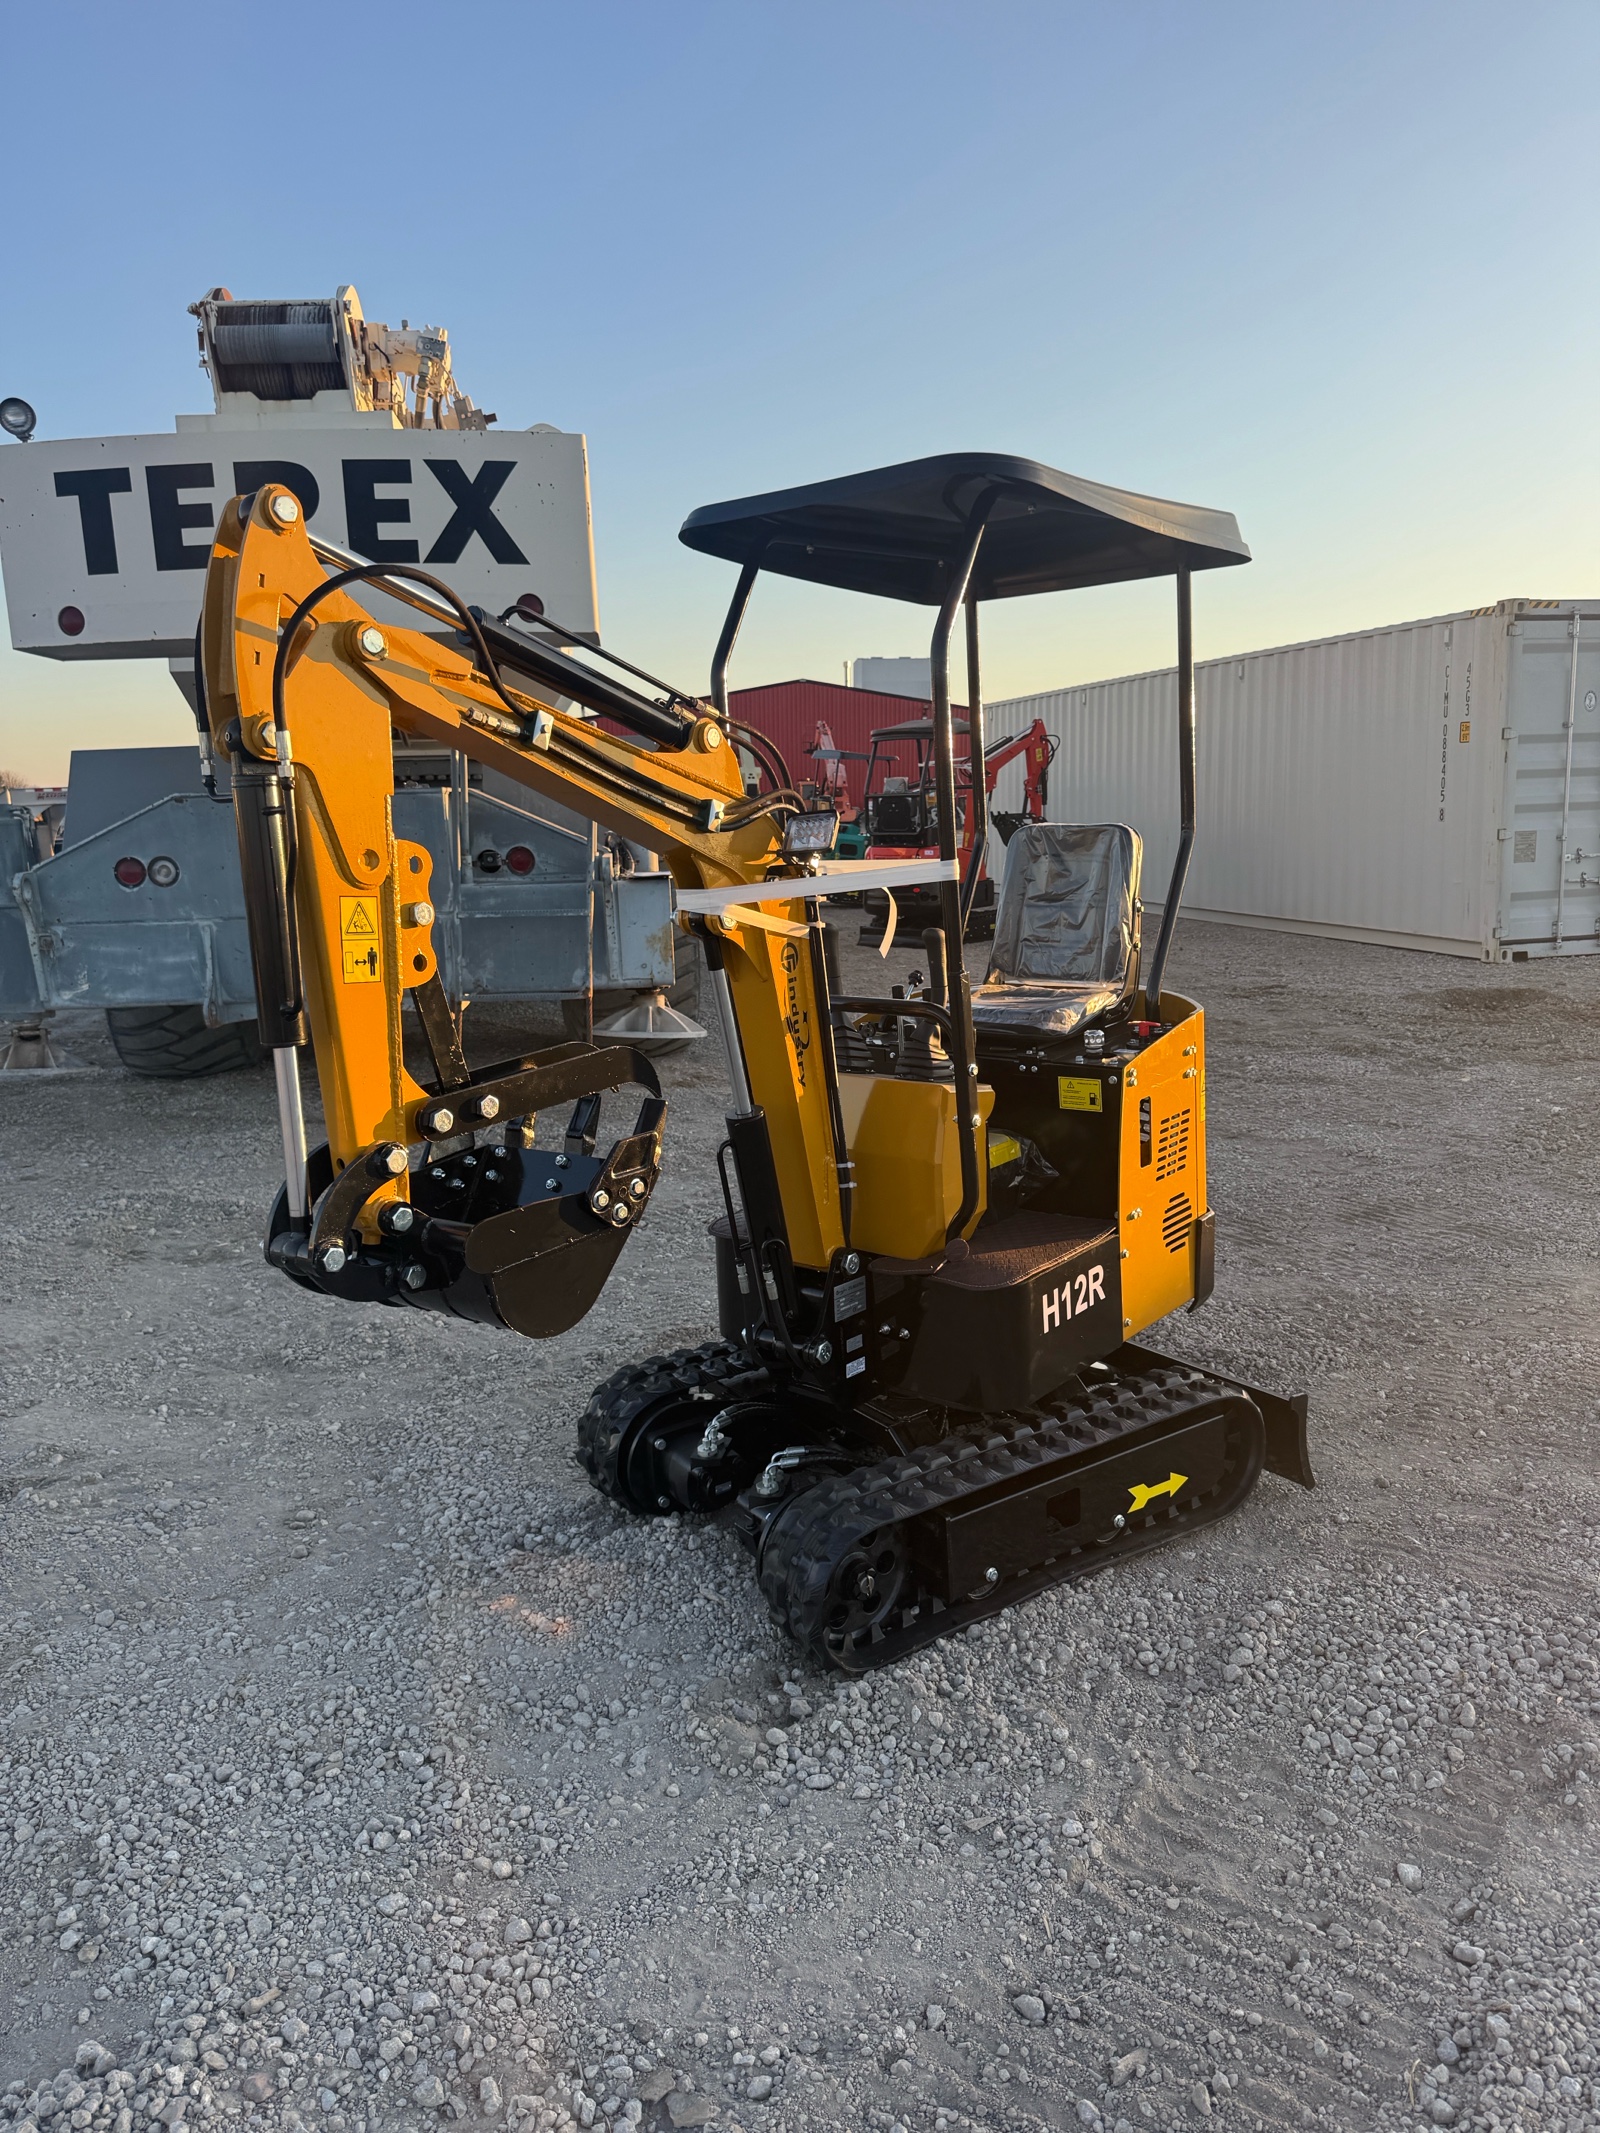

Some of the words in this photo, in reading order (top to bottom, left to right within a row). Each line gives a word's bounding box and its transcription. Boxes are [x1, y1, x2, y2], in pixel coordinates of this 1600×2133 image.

[1464, 662, 1472, 717] 45G3
[1440, 723, 1448, 803] 088405
[1042, 1264, 1106, 1335] H12R
